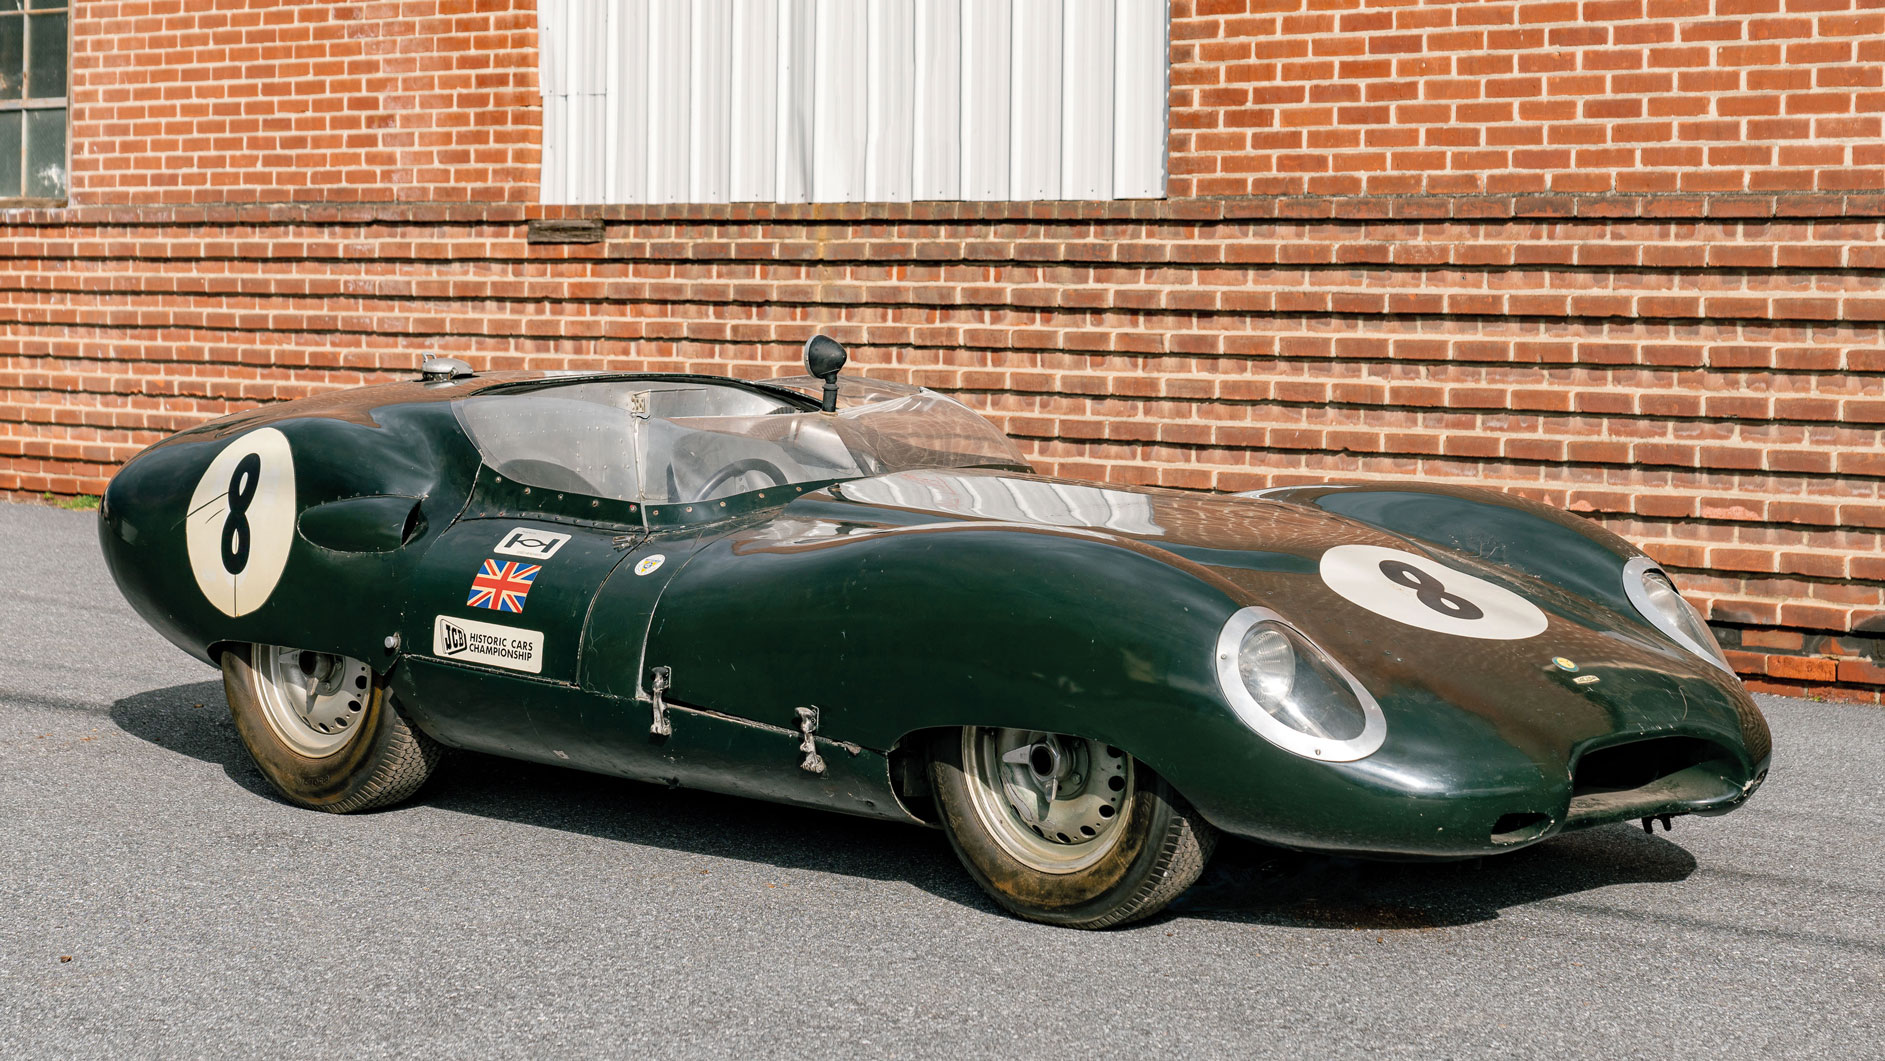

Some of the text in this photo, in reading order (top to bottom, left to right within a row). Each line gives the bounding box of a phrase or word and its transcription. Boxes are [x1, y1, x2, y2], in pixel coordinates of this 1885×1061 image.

[221, 453, 261, 575] 8
[1379, 560, 1484, 620] 8
[444, 623, 464, 651] JCB
[469, 633, 533, 652] HISTORIC CARS
[469, 643, 532, 662] CHAMPIONSHIP
